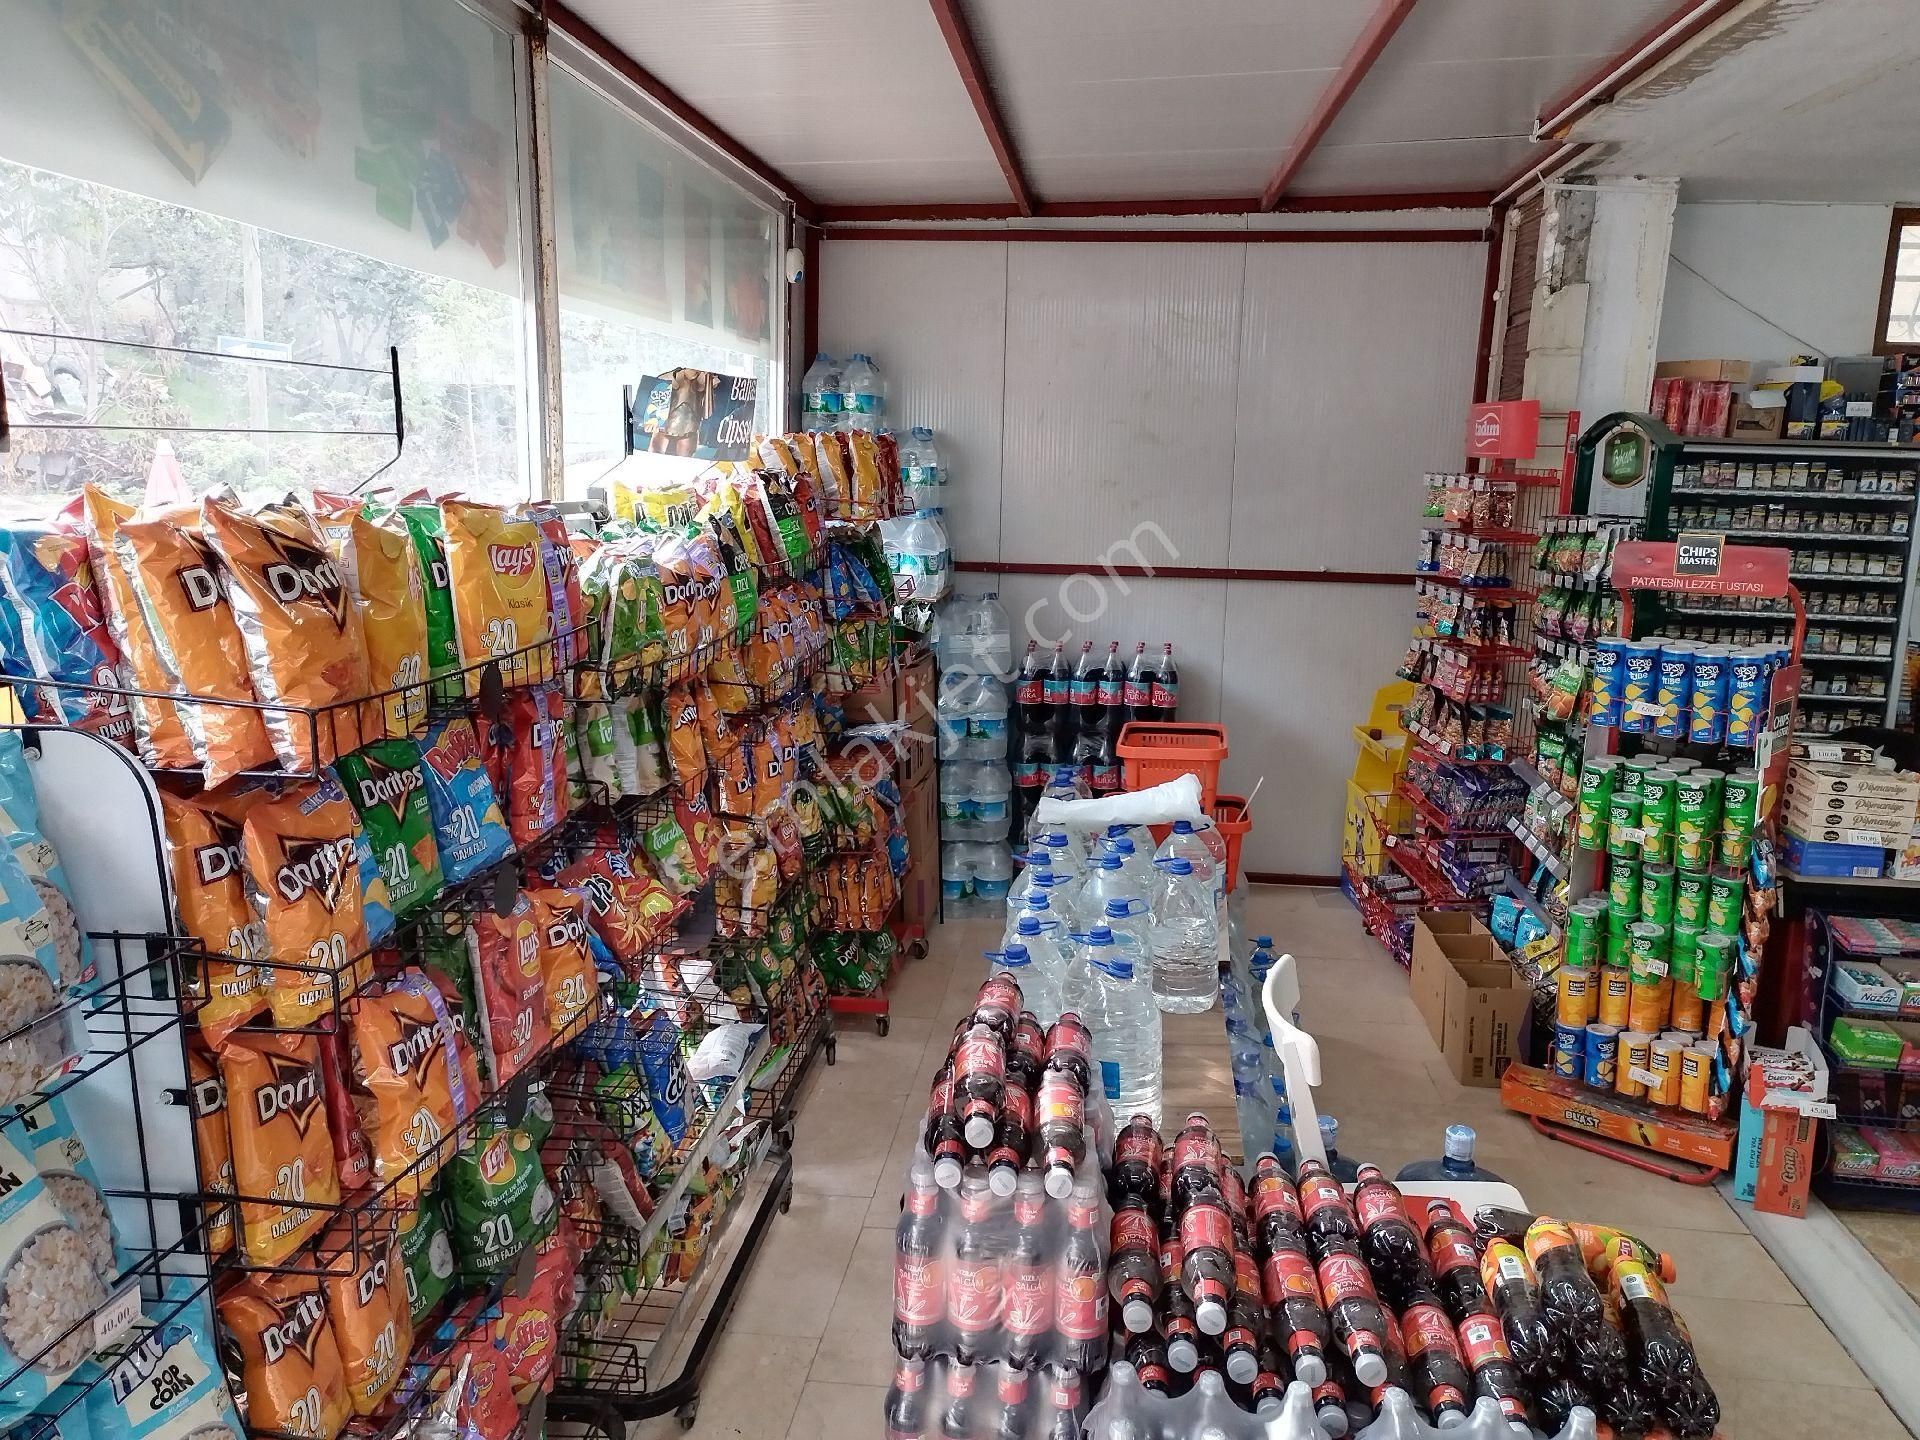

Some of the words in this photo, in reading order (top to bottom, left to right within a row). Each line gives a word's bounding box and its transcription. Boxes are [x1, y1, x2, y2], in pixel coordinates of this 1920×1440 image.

[490, 543, 535, 577] Lay's
[1679, 545, 1718, 557] CHIPS
[1679, 557, 1717, 566] MASTER
[1631, 576, 1683, 589] PATATESİN
[1685, 580, 1726, 590] LEZZET
[1726, 581, 1763, 593] USTASI
[507, 597, 534, 610] Klasik
[359, 765, 424, 808] Doritos
[379, 842, 410, 887] %20
[1861, 992, 1895, 1004] Nazar
[1767, 1073, 1795, 1082] bueno
[473, 1213, 514, 1255] %20
[476, 1252, 500, 1269] DAHA
[500, 1240, 525, 1261] FAZLA
[264, 1295, 322, 1362] Dorit
[152, 1363, 180, 1391] POP
[150, 1373, 194, 1411] CORN
